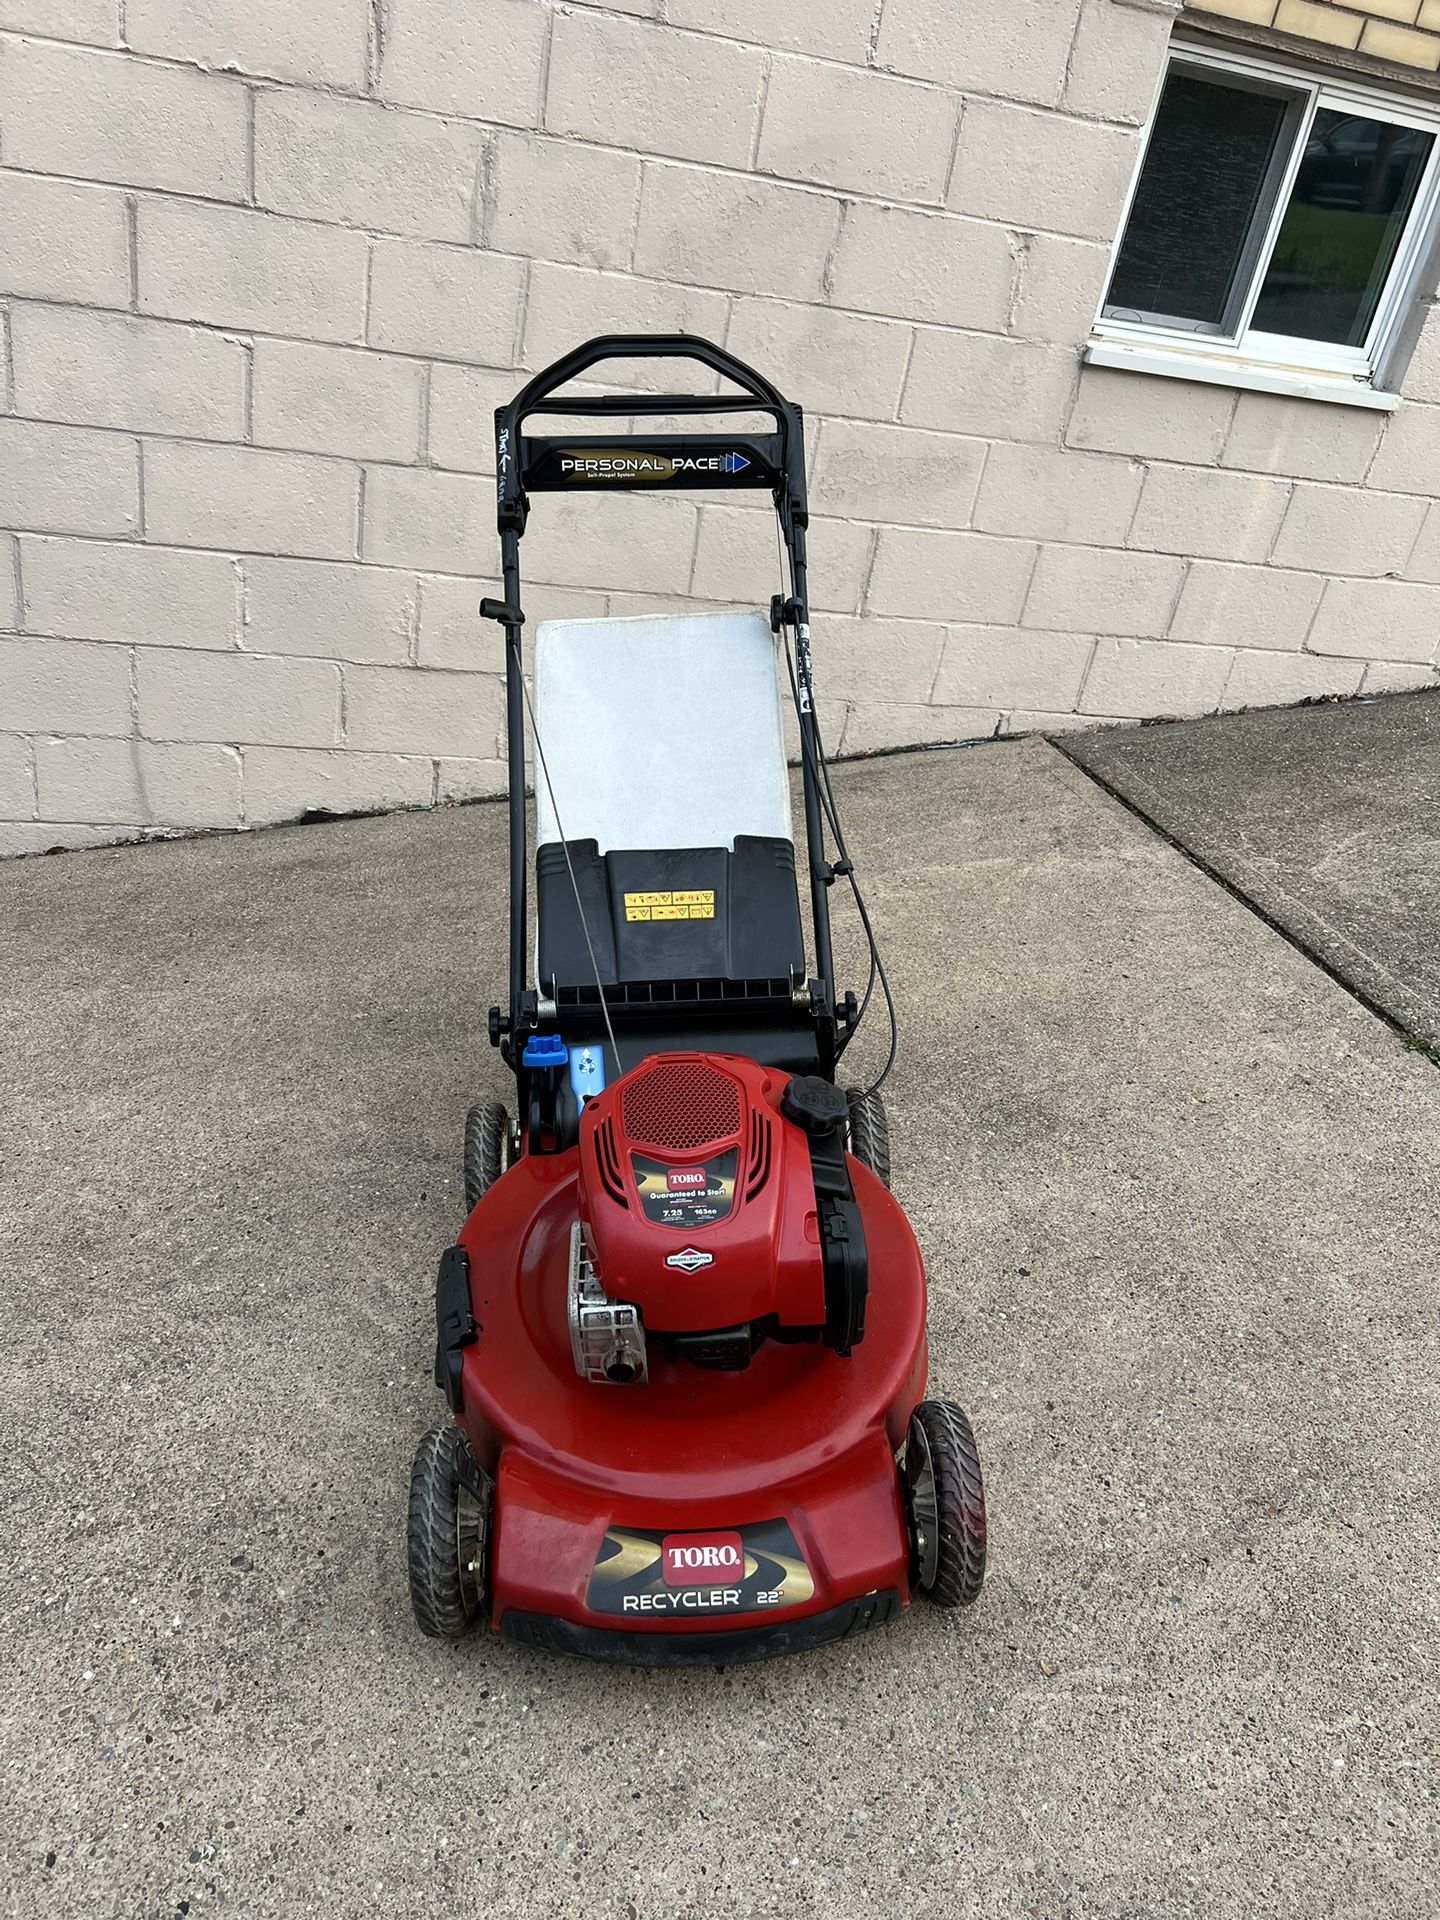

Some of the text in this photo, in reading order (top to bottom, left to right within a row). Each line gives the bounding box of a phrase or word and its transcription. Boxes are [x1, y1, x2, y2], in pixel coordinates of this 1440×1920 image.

[561, 458, 719, 472] PERSONAL PACE
[670, 1173, 703, 1184] TORO
[649, 1190, 697, 1199] Guaranteed
[662, 1209, 683, 1217] 7.25
[669, 1546, 738, 1568] TORO
[623, 1591, 738, 1611] RECYCLER
